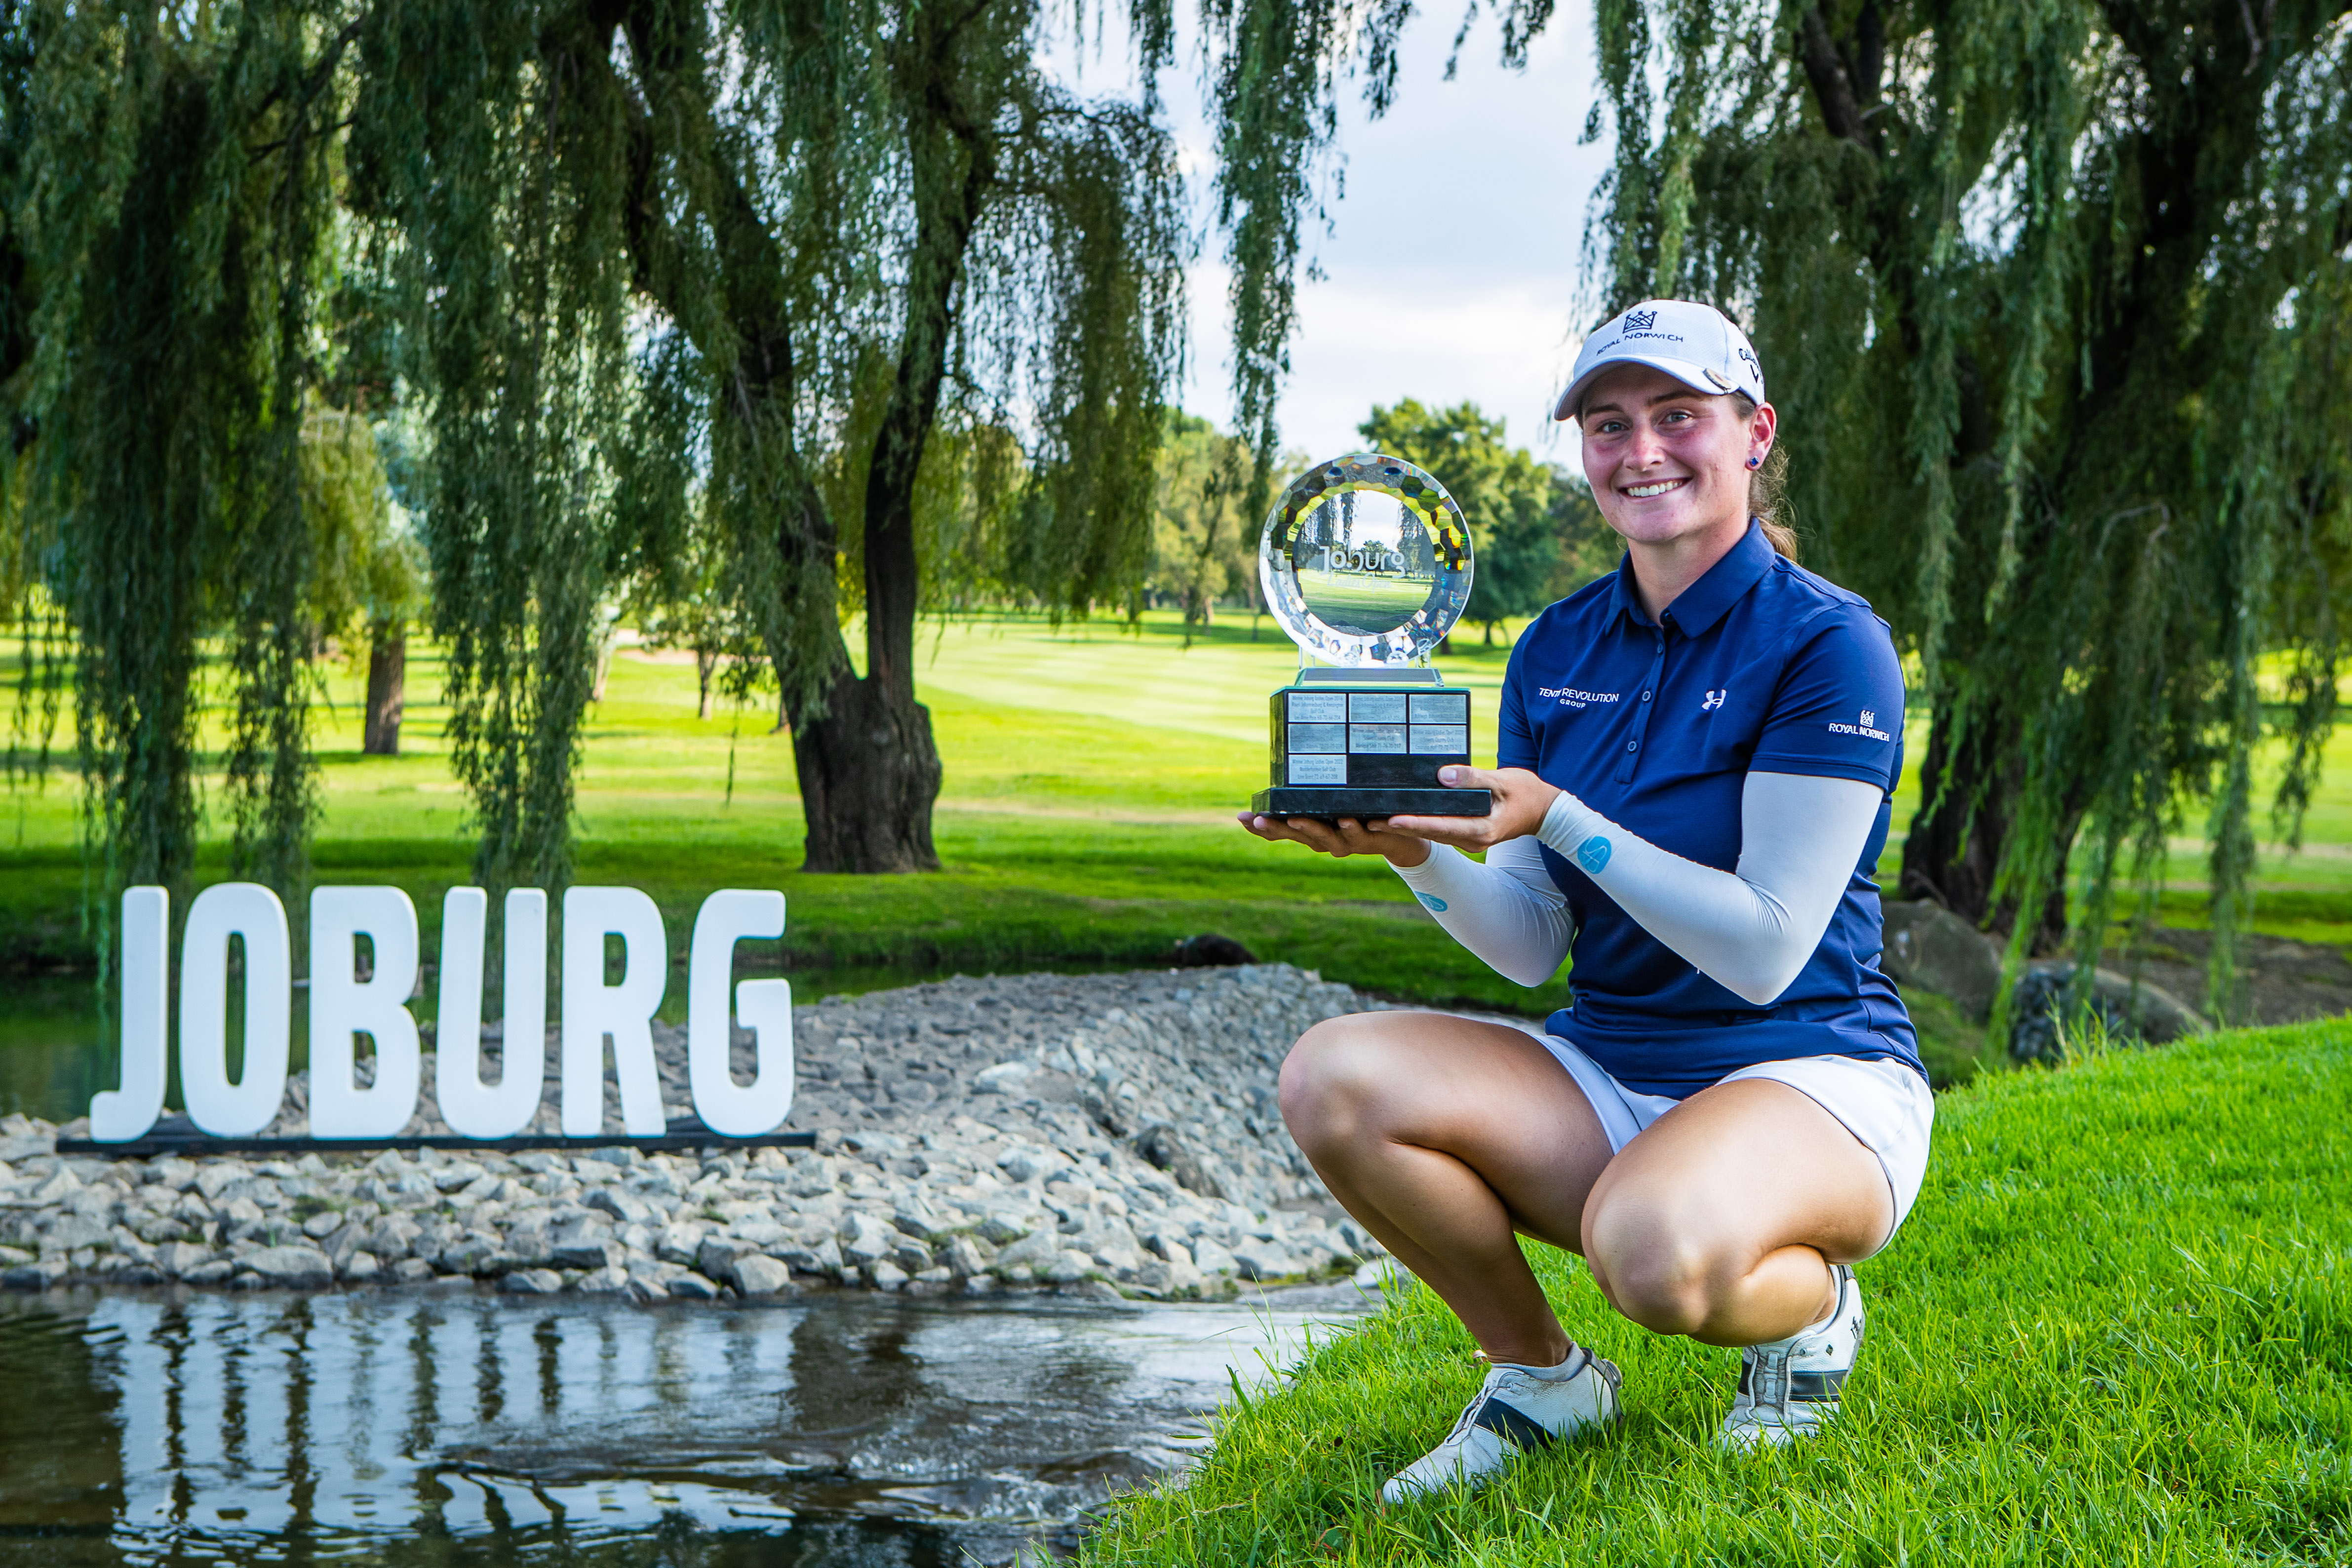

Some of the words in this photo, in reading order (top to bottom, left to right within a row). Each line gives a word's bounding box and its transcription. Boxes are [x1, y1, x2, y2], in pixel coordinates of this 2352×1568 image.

[1596, 339, 1620, 356] ROYAL
[1624, 332, 1683, 342] NORWICH
[1562, 688, 1619, 703] REVOLUTION
[1560, 699, 1586, 708] GROUP
[1829, 723, 1858, 735] ROYAL
[89, 882, 794, 1143] JOBURG
